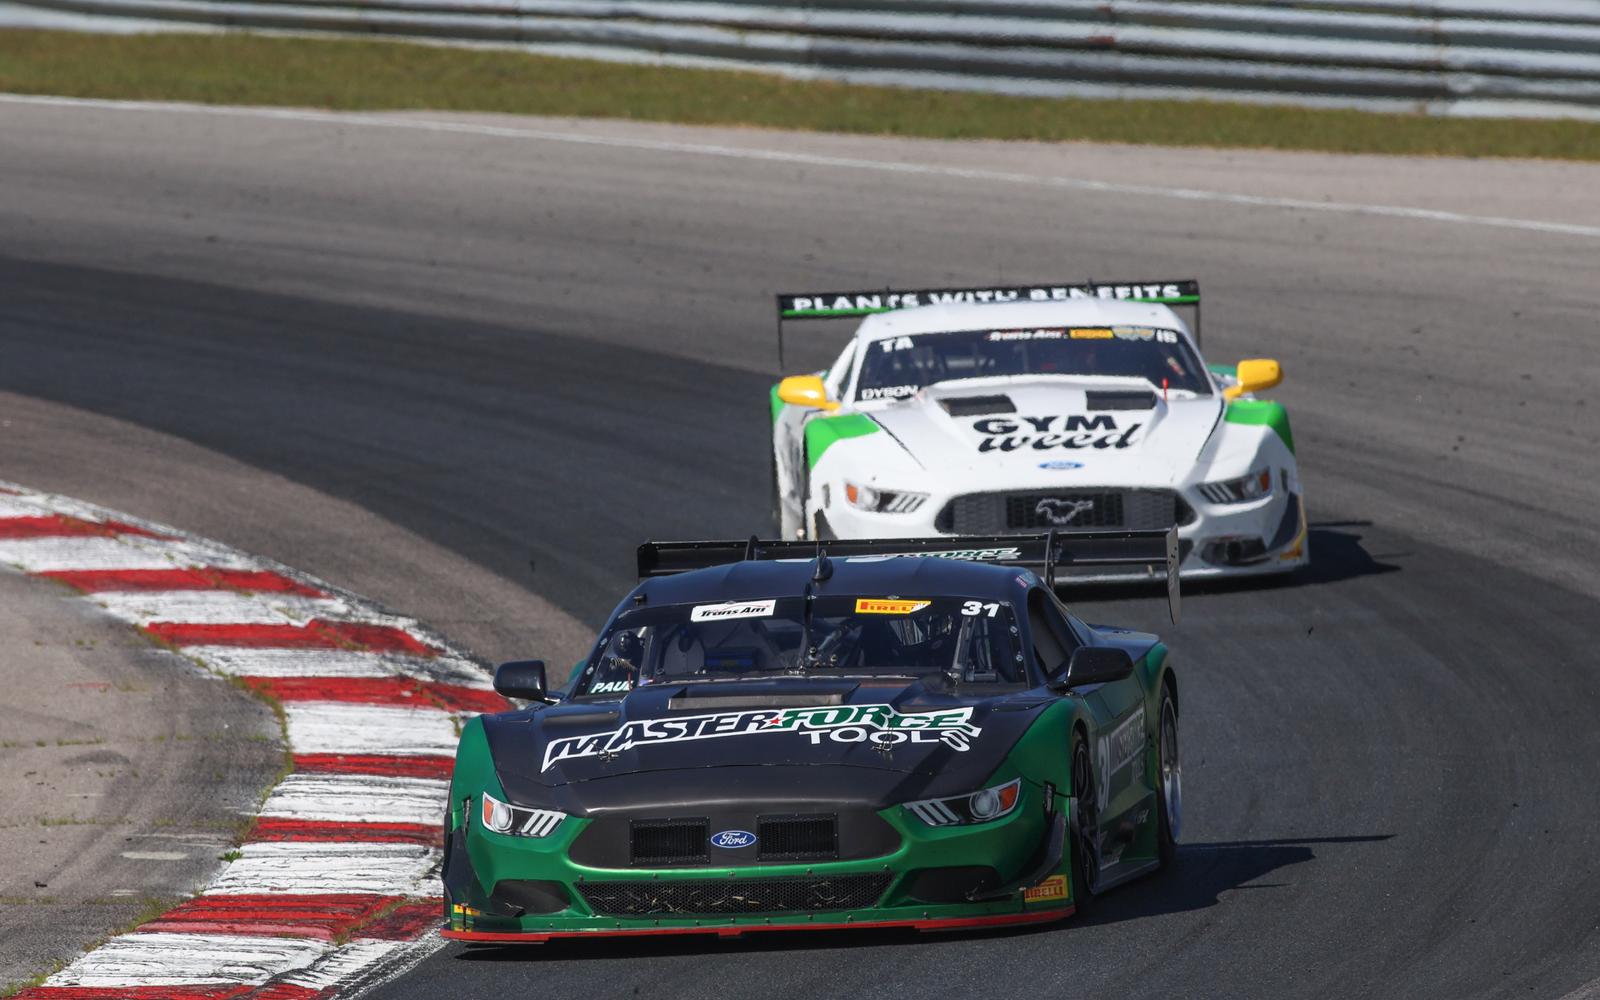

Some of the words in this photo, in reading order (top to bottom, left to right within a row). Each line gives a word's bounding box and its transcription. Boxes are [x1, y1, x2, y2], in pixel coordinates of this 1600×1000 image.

[793, 293, 919, 311] PLANTS
[928, 291, 1018, 304] WITH
[1029, 285, 1181, 301] BENEFITS
[880, 335, 914, 352] TA
[861, 384, 919, 400] DYSON
[973, 415, 1118, 435] GYM
[978, 424, 1142, 452] weed
[700, 608, 739, 617] Trans
[740, 606, 766, 614] Am
[860, 601, 917, 611] PIREL
[960, 600, 1000, 618] 31
[798, 727, 970, 752] TOOLS
[719, 832, 748, 845] Ford
